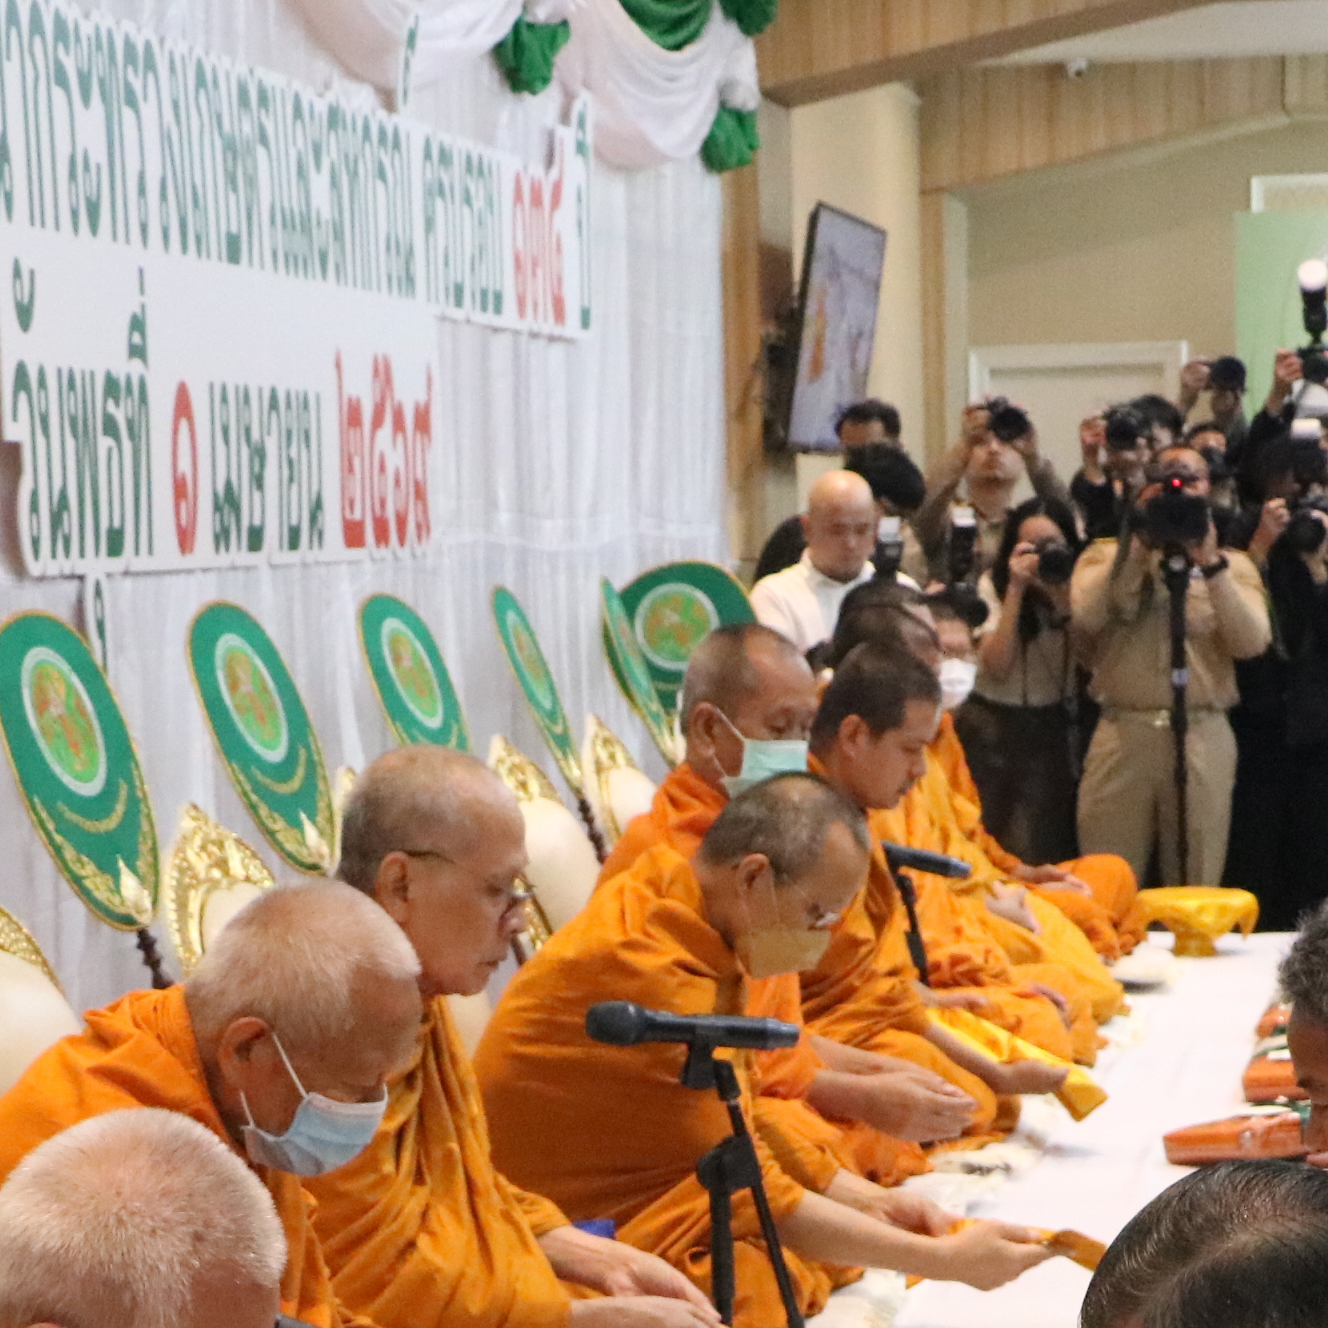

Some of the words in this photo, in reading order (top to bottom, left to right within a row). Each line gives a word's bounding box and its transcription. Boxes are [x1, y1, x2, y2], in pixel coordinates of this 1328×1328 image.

[171, 380, 199, 556] ๑
[210, 380, 325, 553] เมษายน
